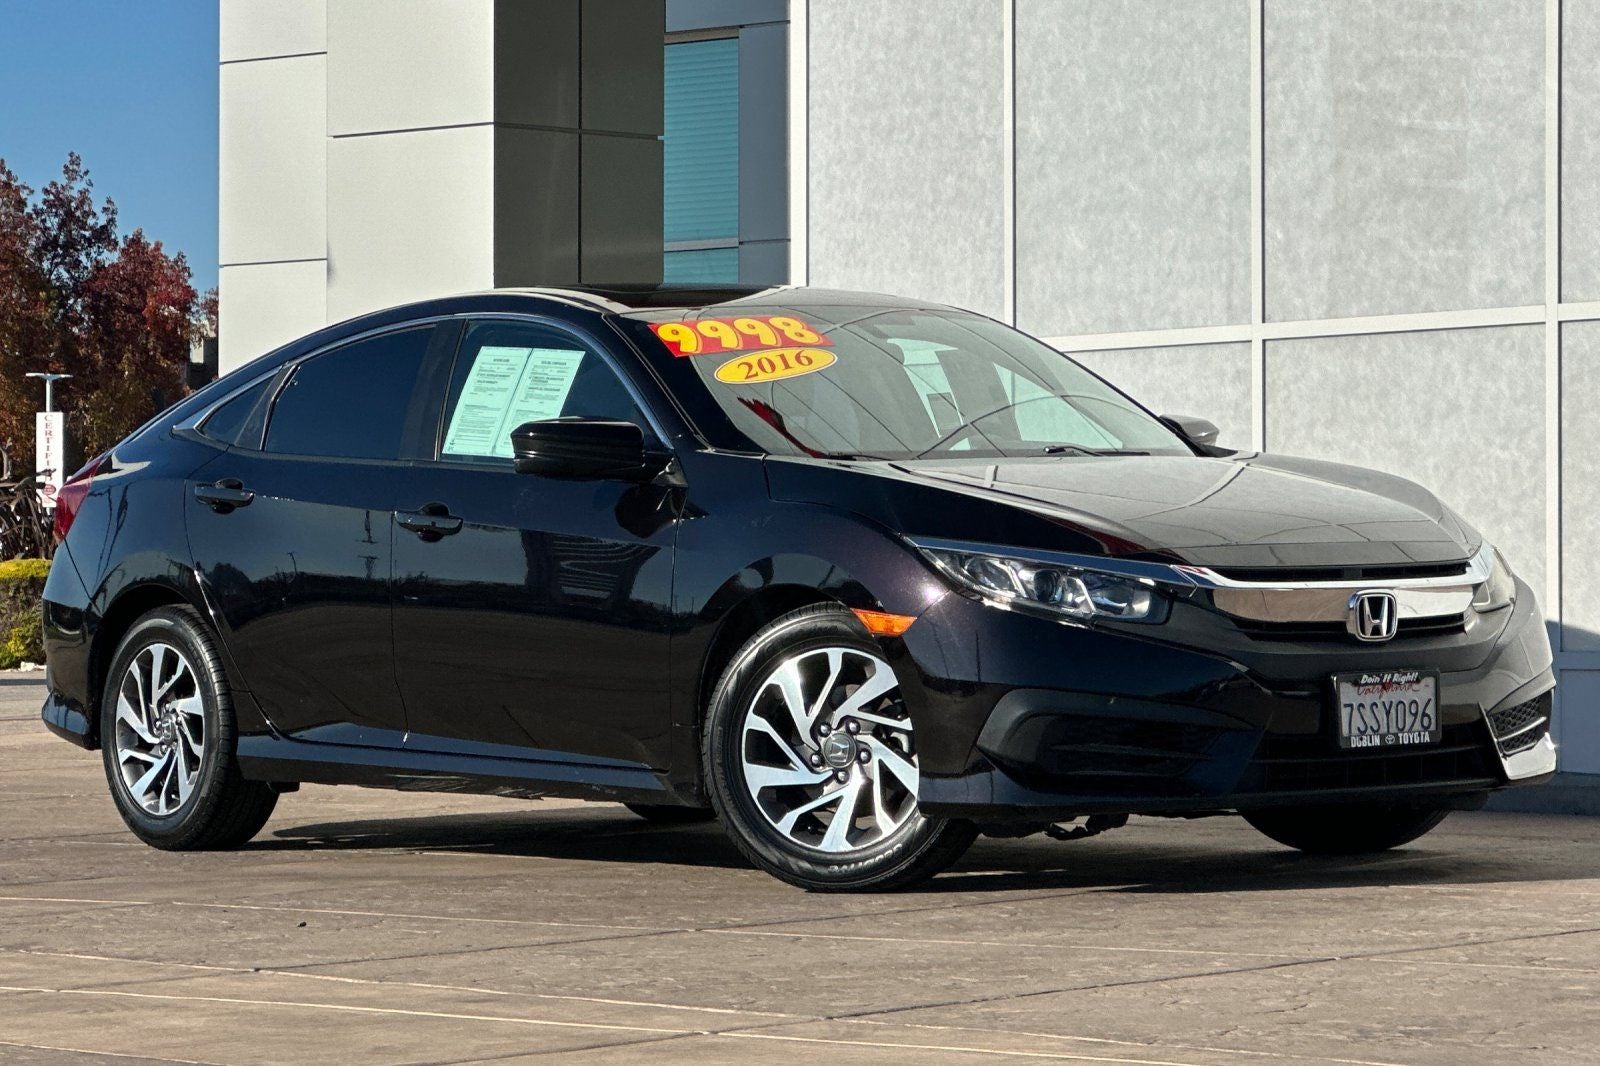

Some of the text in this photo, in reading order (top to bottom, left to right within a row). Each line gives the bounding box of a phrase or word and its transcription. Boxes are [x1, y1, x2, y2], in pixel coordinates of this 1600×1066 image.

[657, 316, 823, 354] 9998
[737, 350, 813, 380] 2016
[44, 415, 53, 482] CERTIFI
[1392, 672, 1419, 685] Right!
[1343, 698, 1432, 734] 7SSY096
[1351, 732, 1430, 748] DUBLIN TOYOTA
